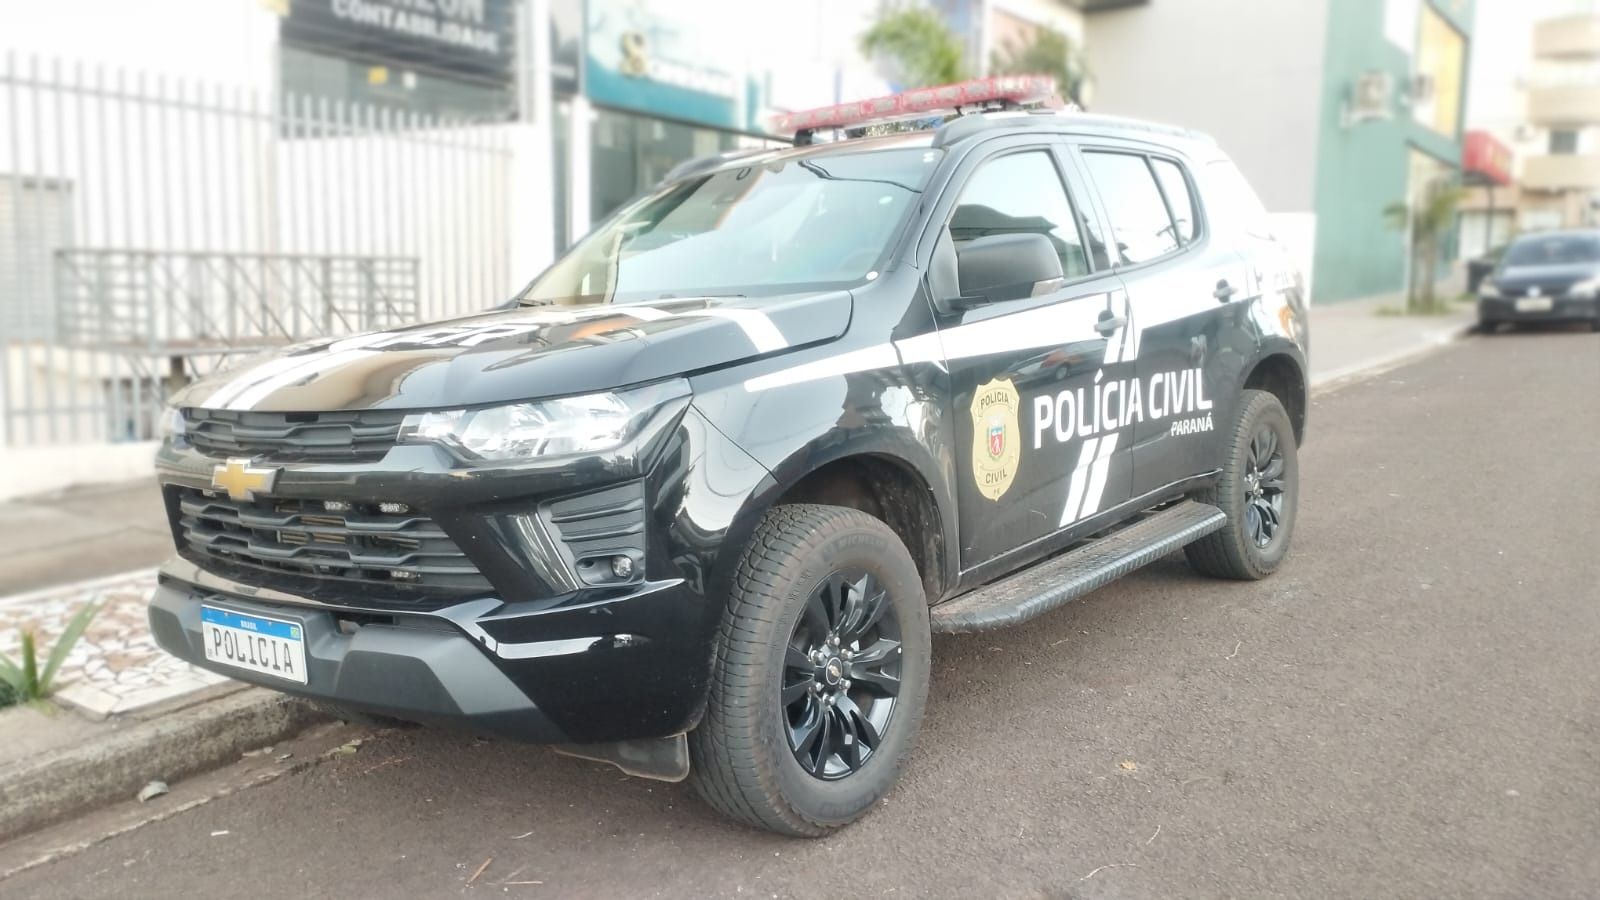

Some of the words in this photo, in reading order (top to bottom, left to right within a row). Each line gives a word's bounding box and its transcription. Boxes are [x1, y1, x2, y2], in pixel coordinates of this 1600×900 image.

[332, 0, 498, 54] CONTABILIDADE
[1034, 368, 1143, 449] POLÍCIA
[1149, 367, 1212, 419] CIVIL
[1170, 412, 1213, 437] PARANÁ
[985, 468, 1007, 484] CIVIL
[213, 627, 294, 674] POLICIA
